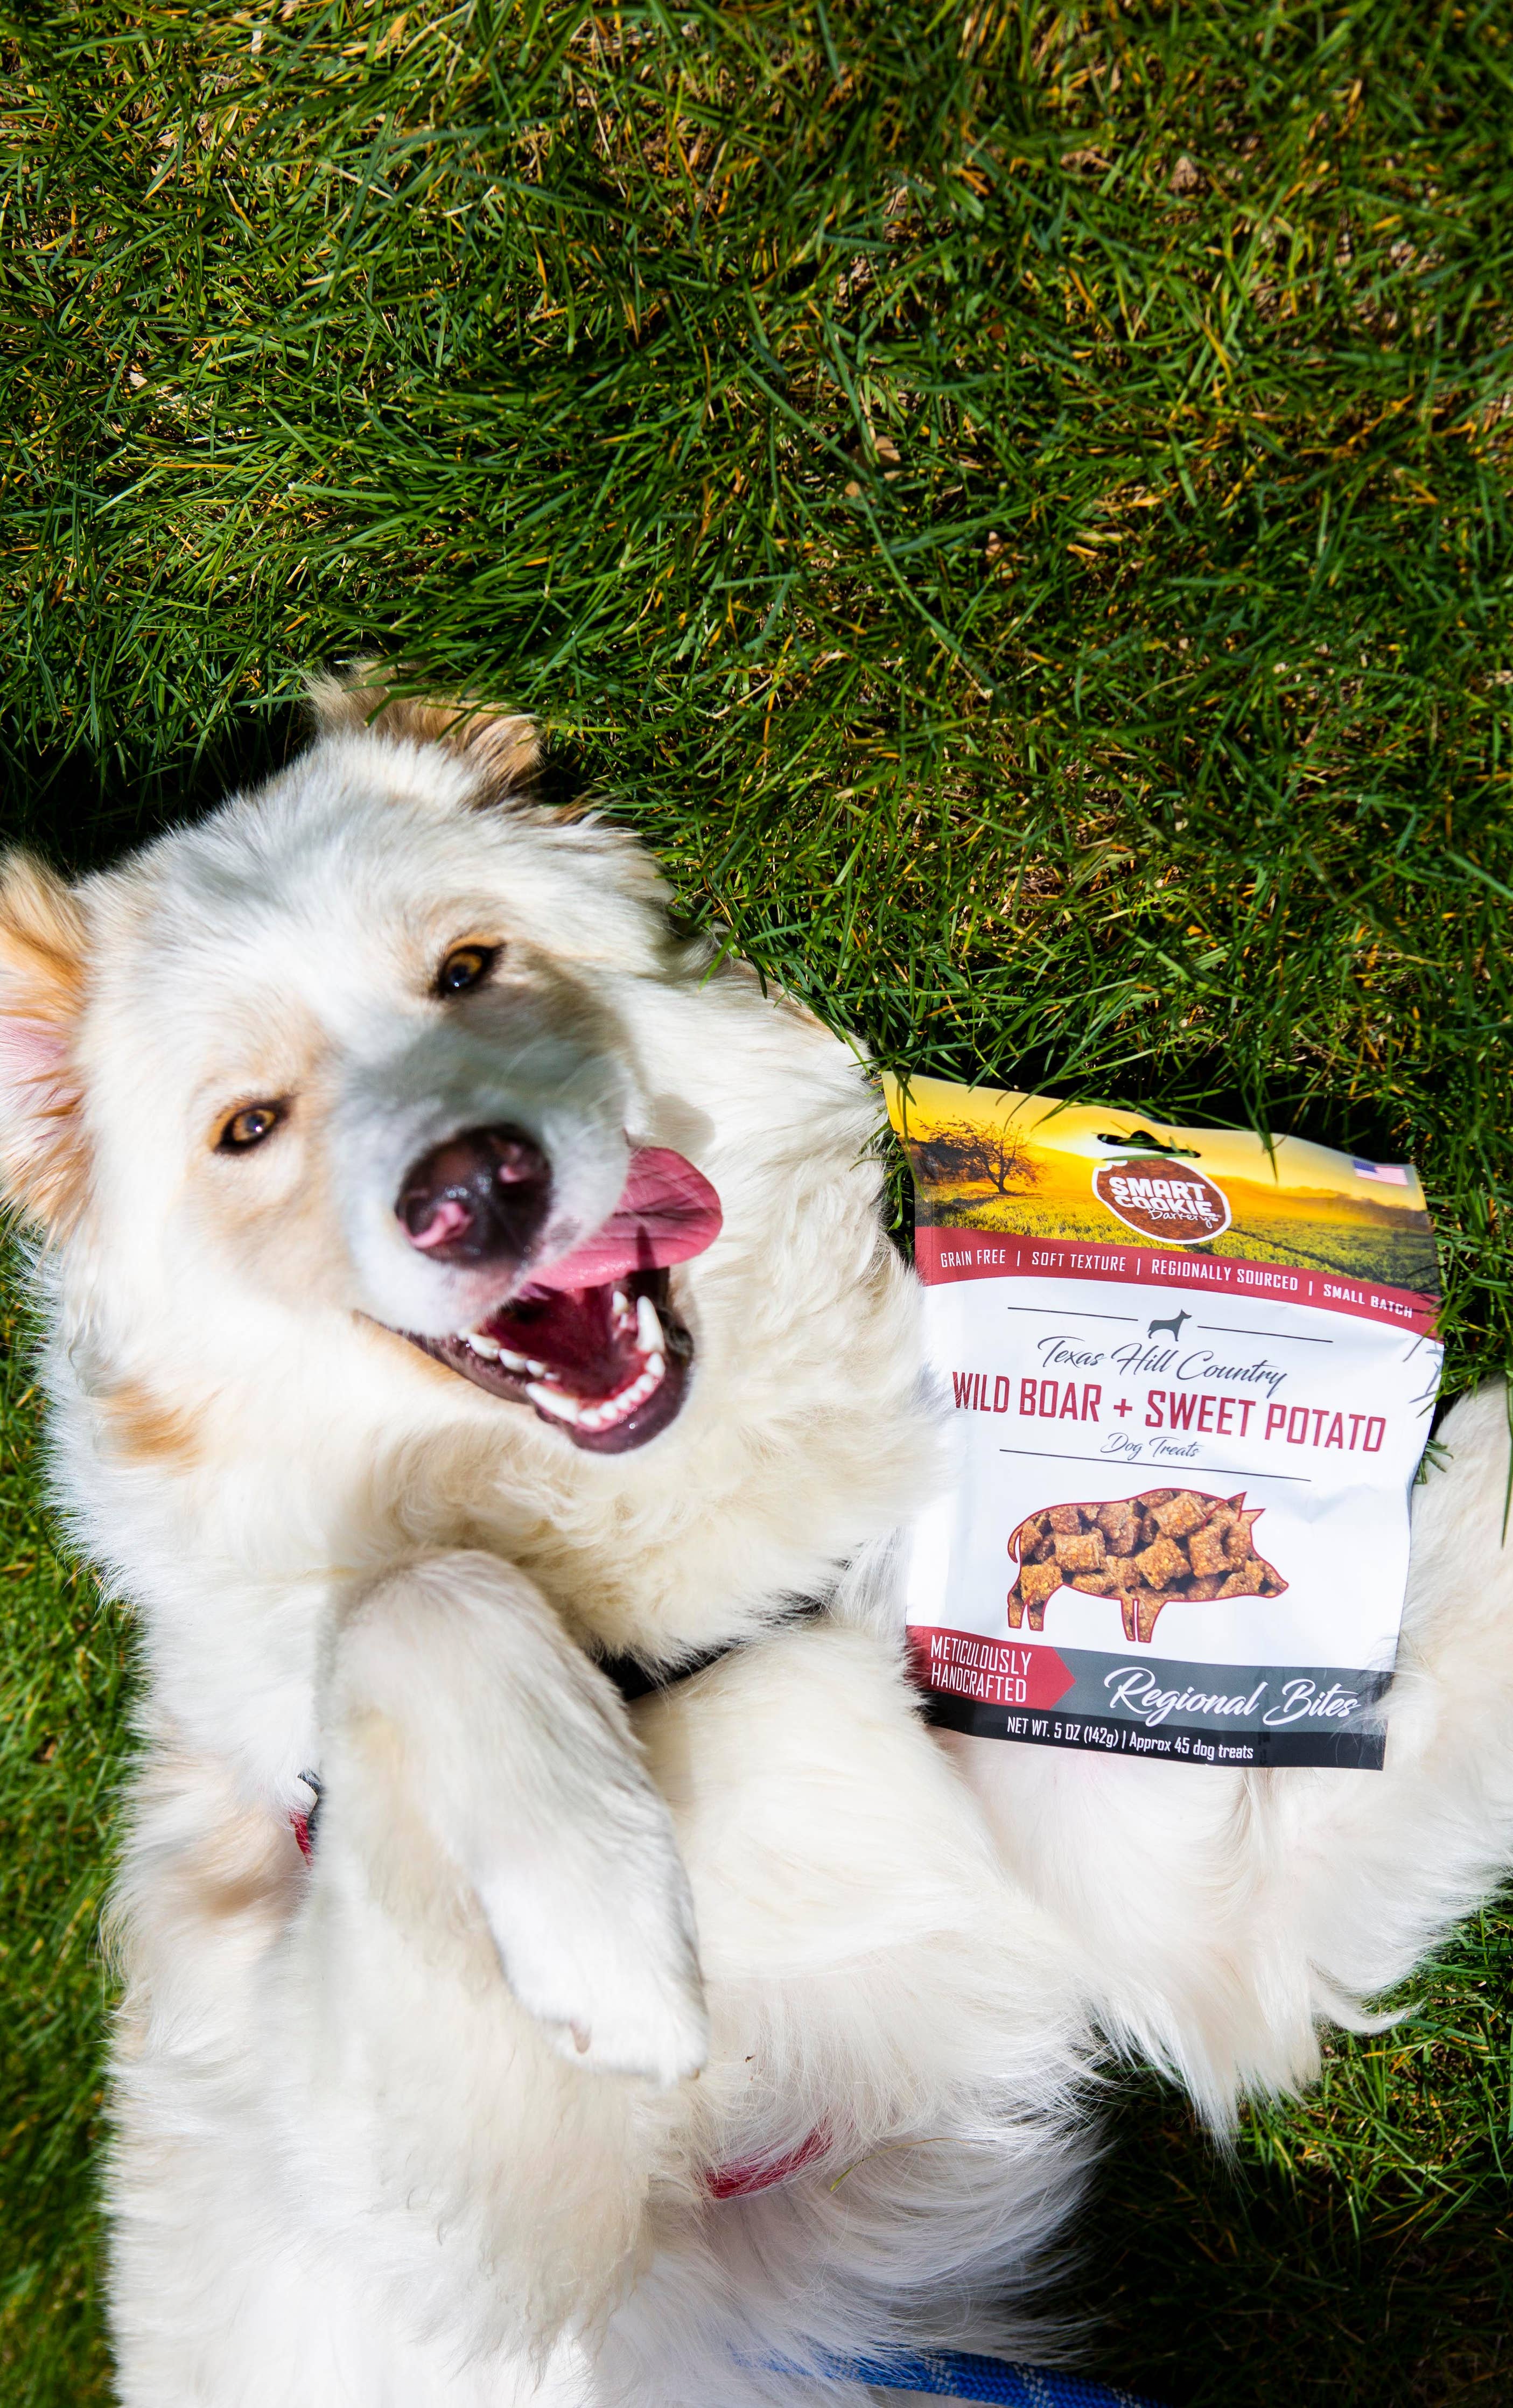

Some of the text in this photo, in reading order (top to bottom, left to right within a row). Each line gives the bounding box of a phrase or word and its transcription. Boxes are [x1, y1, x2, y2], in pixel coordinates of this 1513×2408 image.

[1109, 1177, 1206, 1201] SMART
[1114, 1195, 1218, 1217] COOKIE
[940, 1249, 1413, 1318] GRAIN FREE SOFT TEXTURE REGIONALLY SOURCED SMALL BATCH
[1037, 1336, 1288, 1398] Texas Hill Country
[952, 1371, 1386, 1452] WILD BOAR + SWEET POTATO
[1100, 1432, 1205, 1461] Dog Treats
[930, 1635, 1032, 1675] METICULOUSLY
[931, 1662, 1027, 1703] HANDCRAFTED
[1103, 1666, 1362, 1727] Regional Bites
[1007, 1716, 1254, 1761] NET WT. 5 OZ (142g) Approx 45 dog treats
